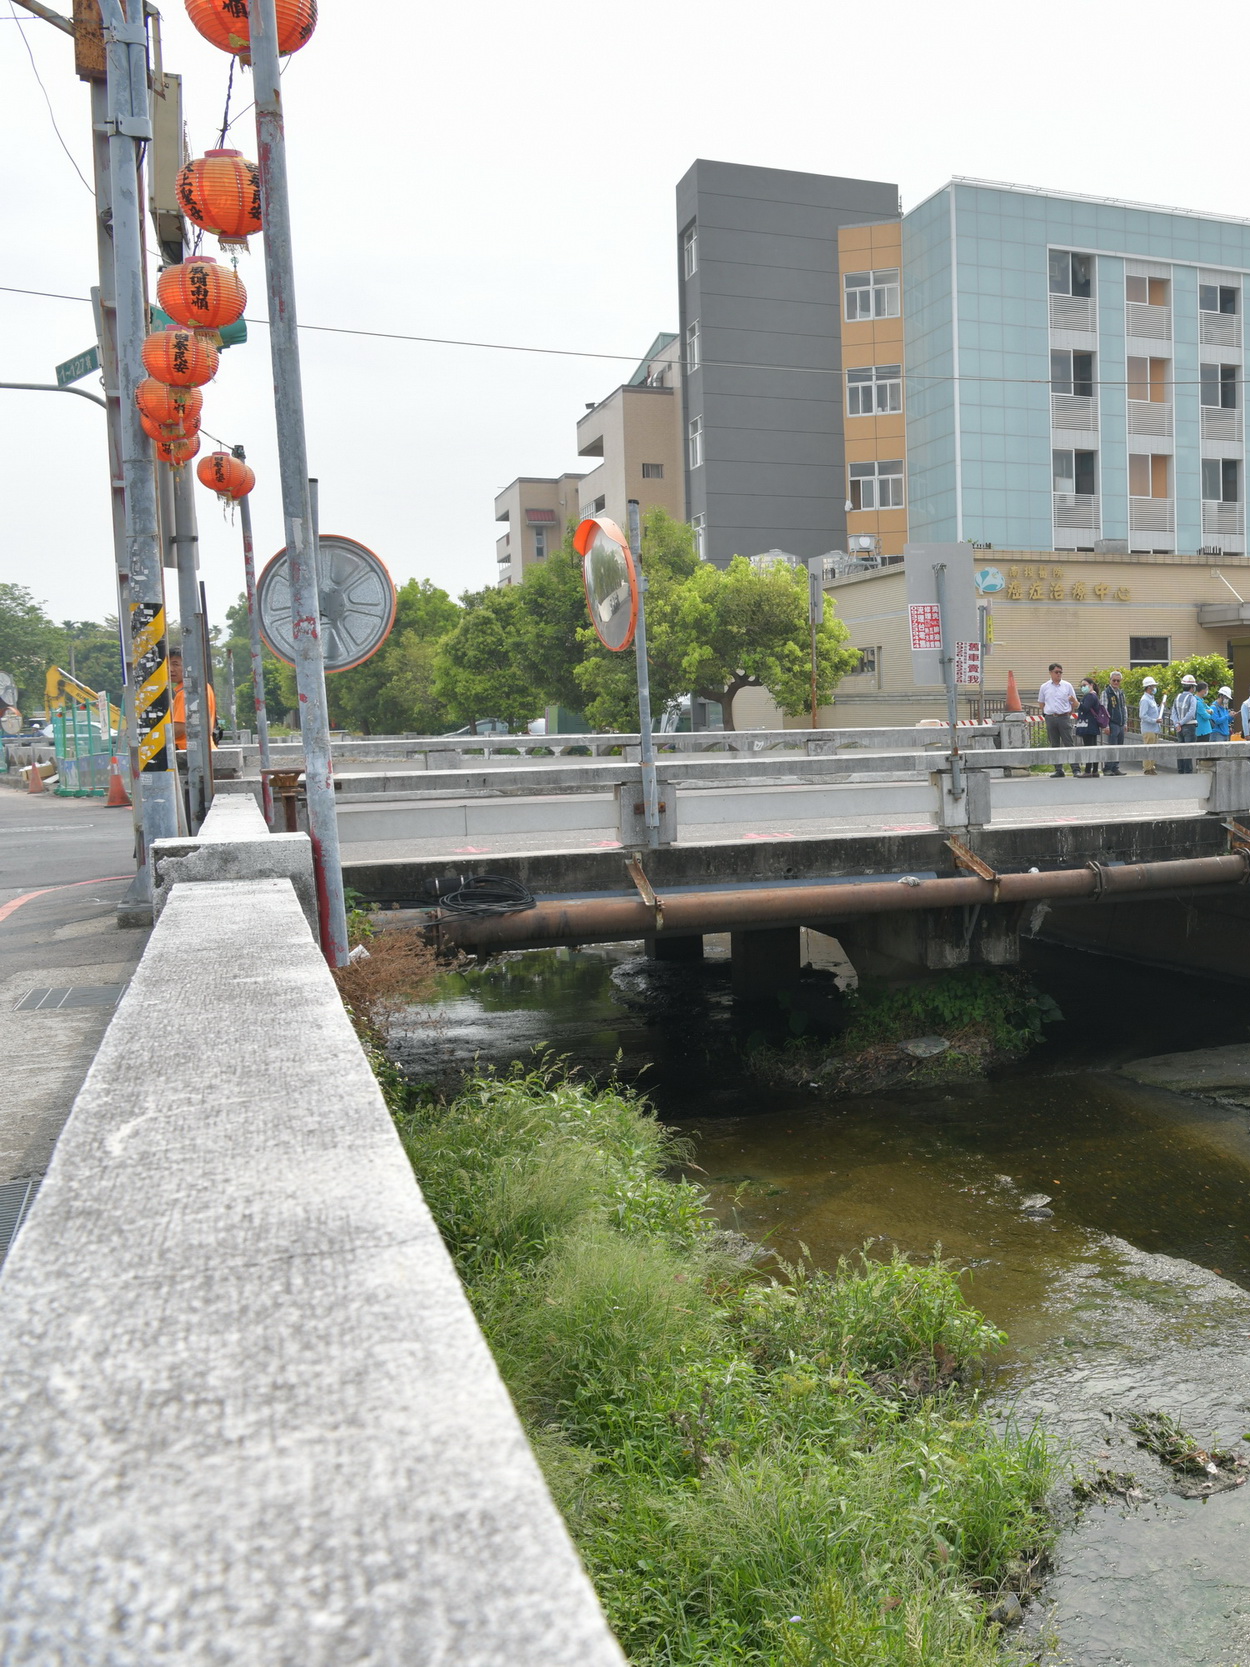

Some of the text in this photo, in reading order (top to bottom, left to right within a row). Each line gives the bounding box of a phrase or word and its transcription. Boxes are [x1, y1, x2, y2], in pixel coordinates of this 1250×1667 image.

[1008, 565, 1064, 579] 南投醫院
[1007, 580, 1132, 601] 癌症治療中心
